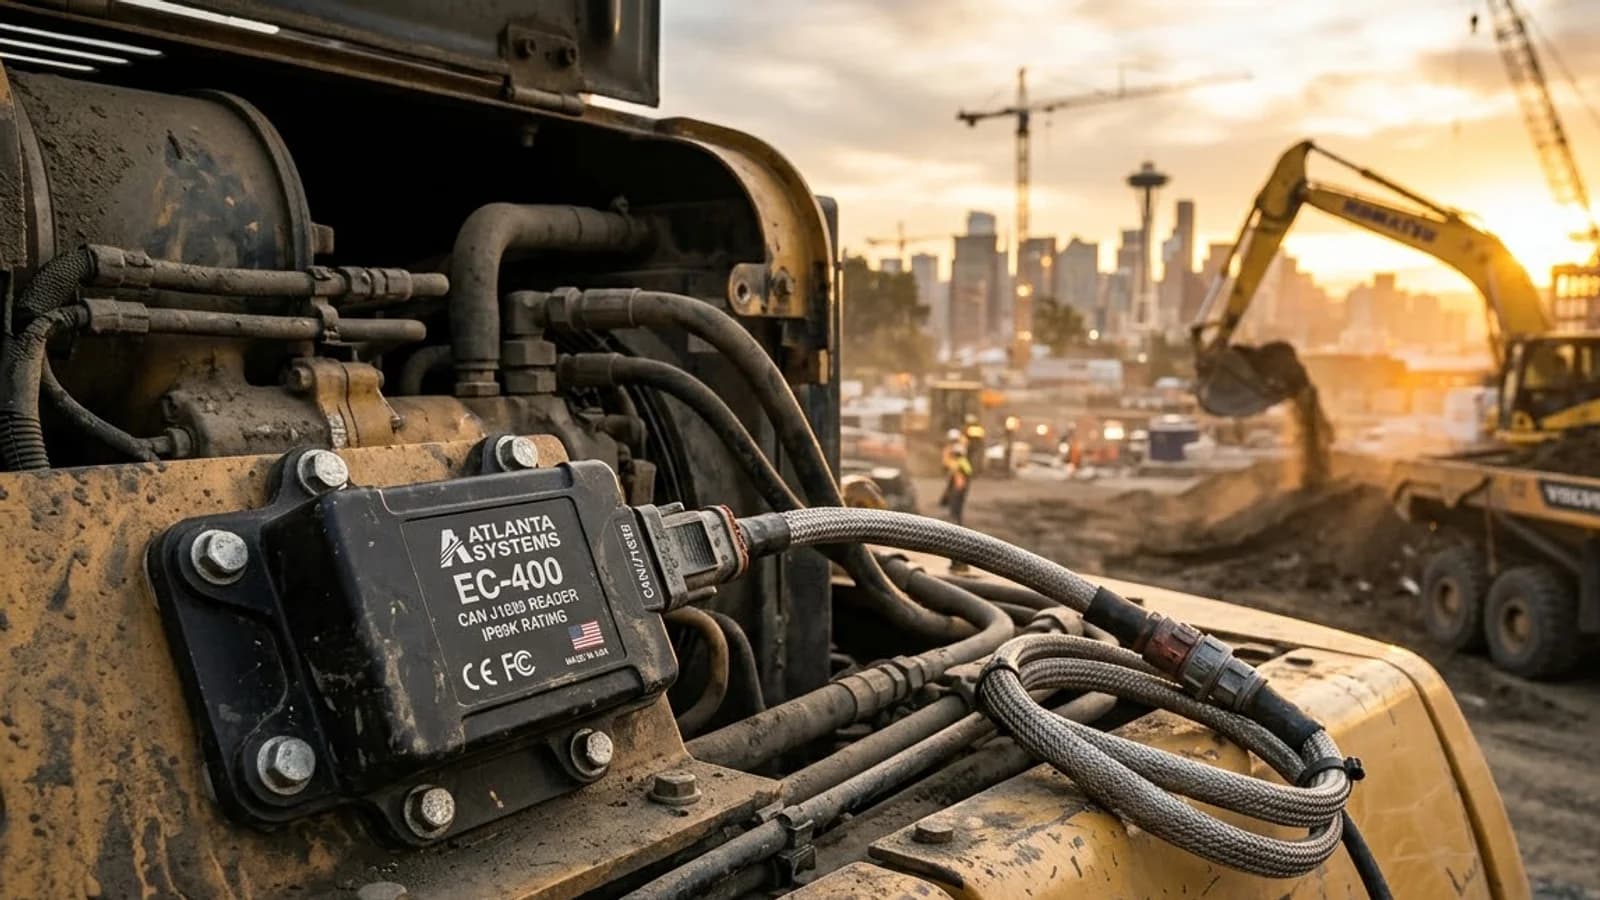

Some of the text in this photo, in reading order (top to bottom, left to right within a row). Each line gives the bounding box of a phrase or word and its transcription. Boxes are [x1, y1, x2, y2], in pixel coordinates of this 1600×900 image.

[468, 514, 556, 543] ATLANTA
[472, 532, 561, 561] SYSTEMS
[453, 556, 563, 605] EC-400
[457, 608, 488, 627] CAN
[527, 588, 580, 611] READER
[520, 609, 568, 632] RATING
[462, 657, 498, 690] CE
